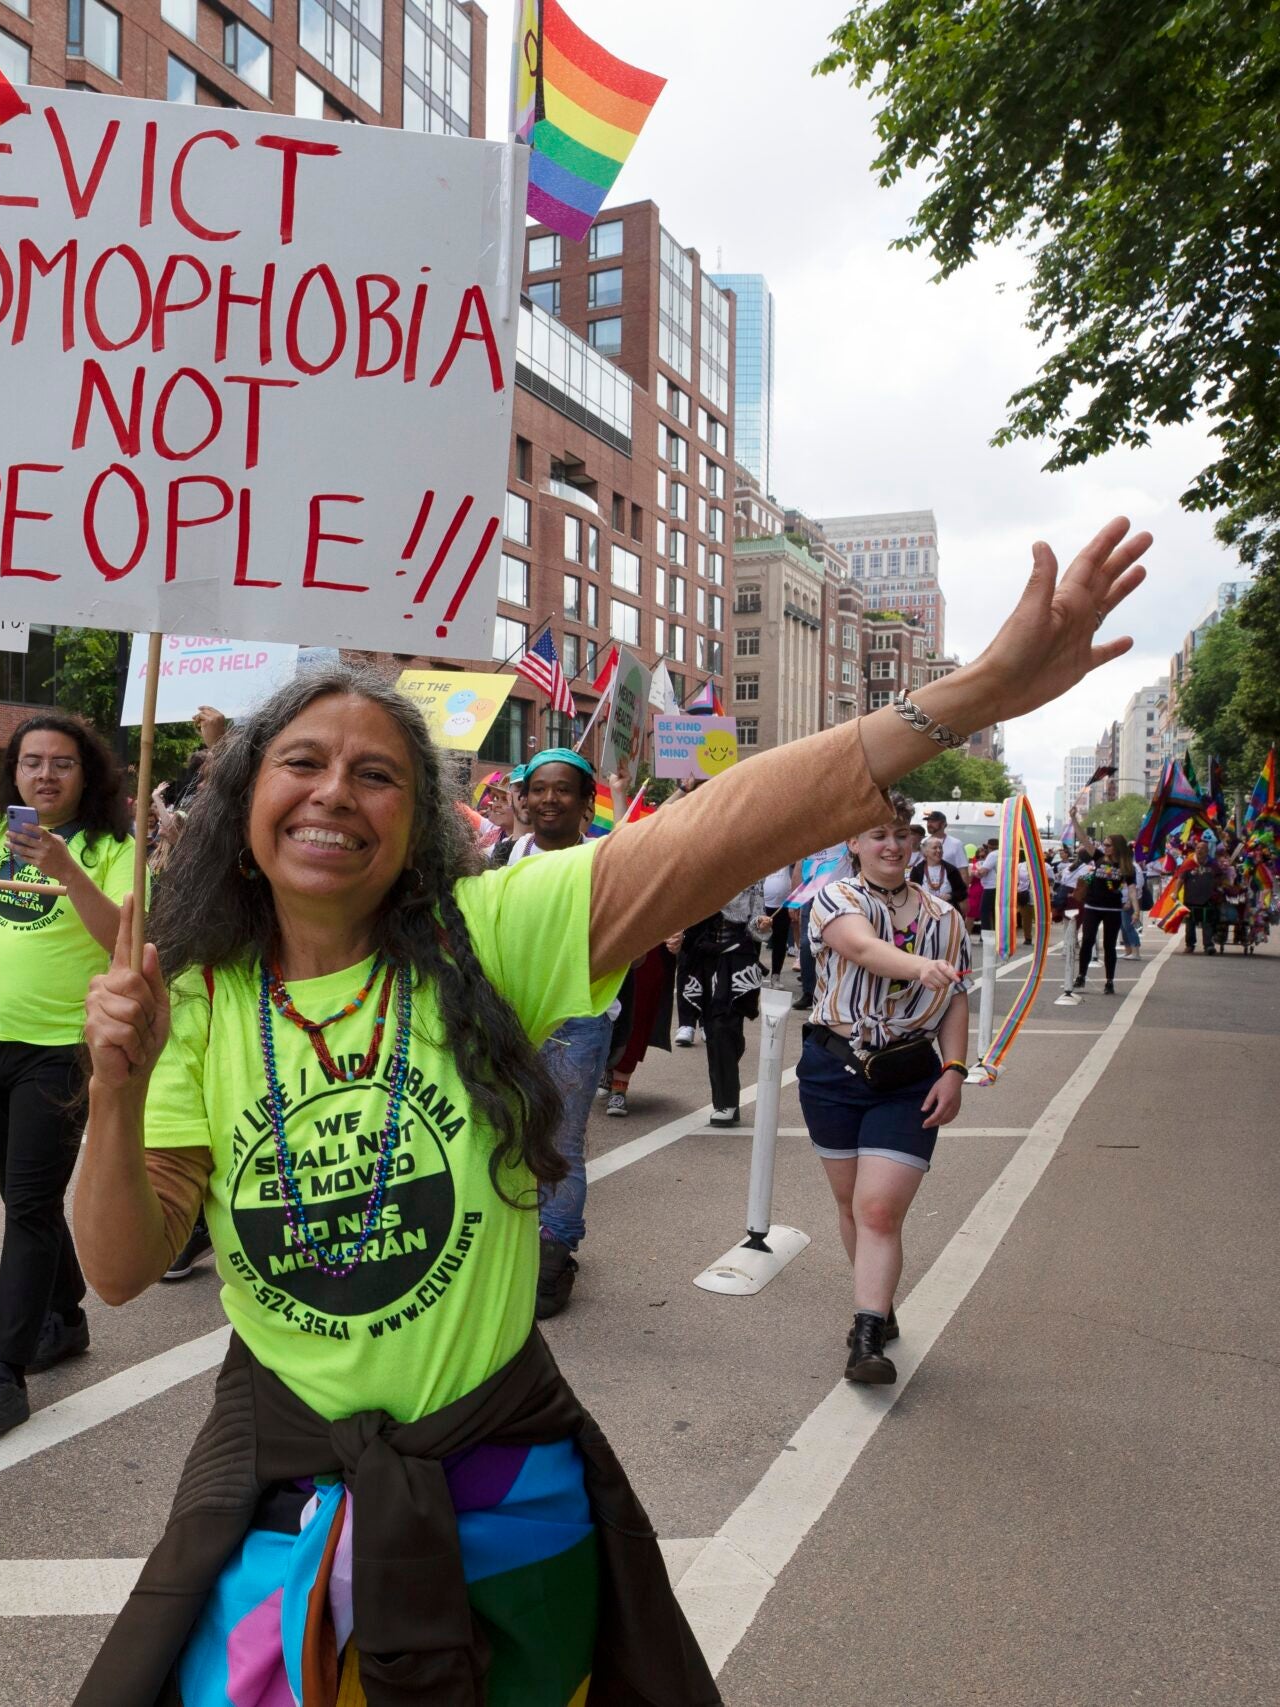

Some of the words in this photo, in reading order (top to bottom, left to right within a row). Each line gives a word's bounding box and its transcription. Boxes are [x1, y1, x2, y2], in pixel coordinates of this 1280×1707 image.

[71, 358, 300, 469] NOT
[138, 659, 173, 679] AK
[178, 656, 214, 676] FOR
[218, 652, 268, 672] HELP
[427, 682, 452, 692] THE
[658, 721, 673, 732] BE
[675, 722, 702, 732] KIND
[659, 735, 674, 744] TO
[676, 736, 706, 745] YOUR
[660, 750, 689, 759] MIND
[13, 908, 65, 931] www.CLVU.org
[314, 1110, 362, 1139] WE
[259, 1178, 303, 1201] BE
[310, 1152, 416, 1197] MOVED
[283, 1218, 330, 1248] NO
[228, 1250, 351, 1341] 617-524-3541
[368, 1211, 483, 1339] www.CLVU.org
